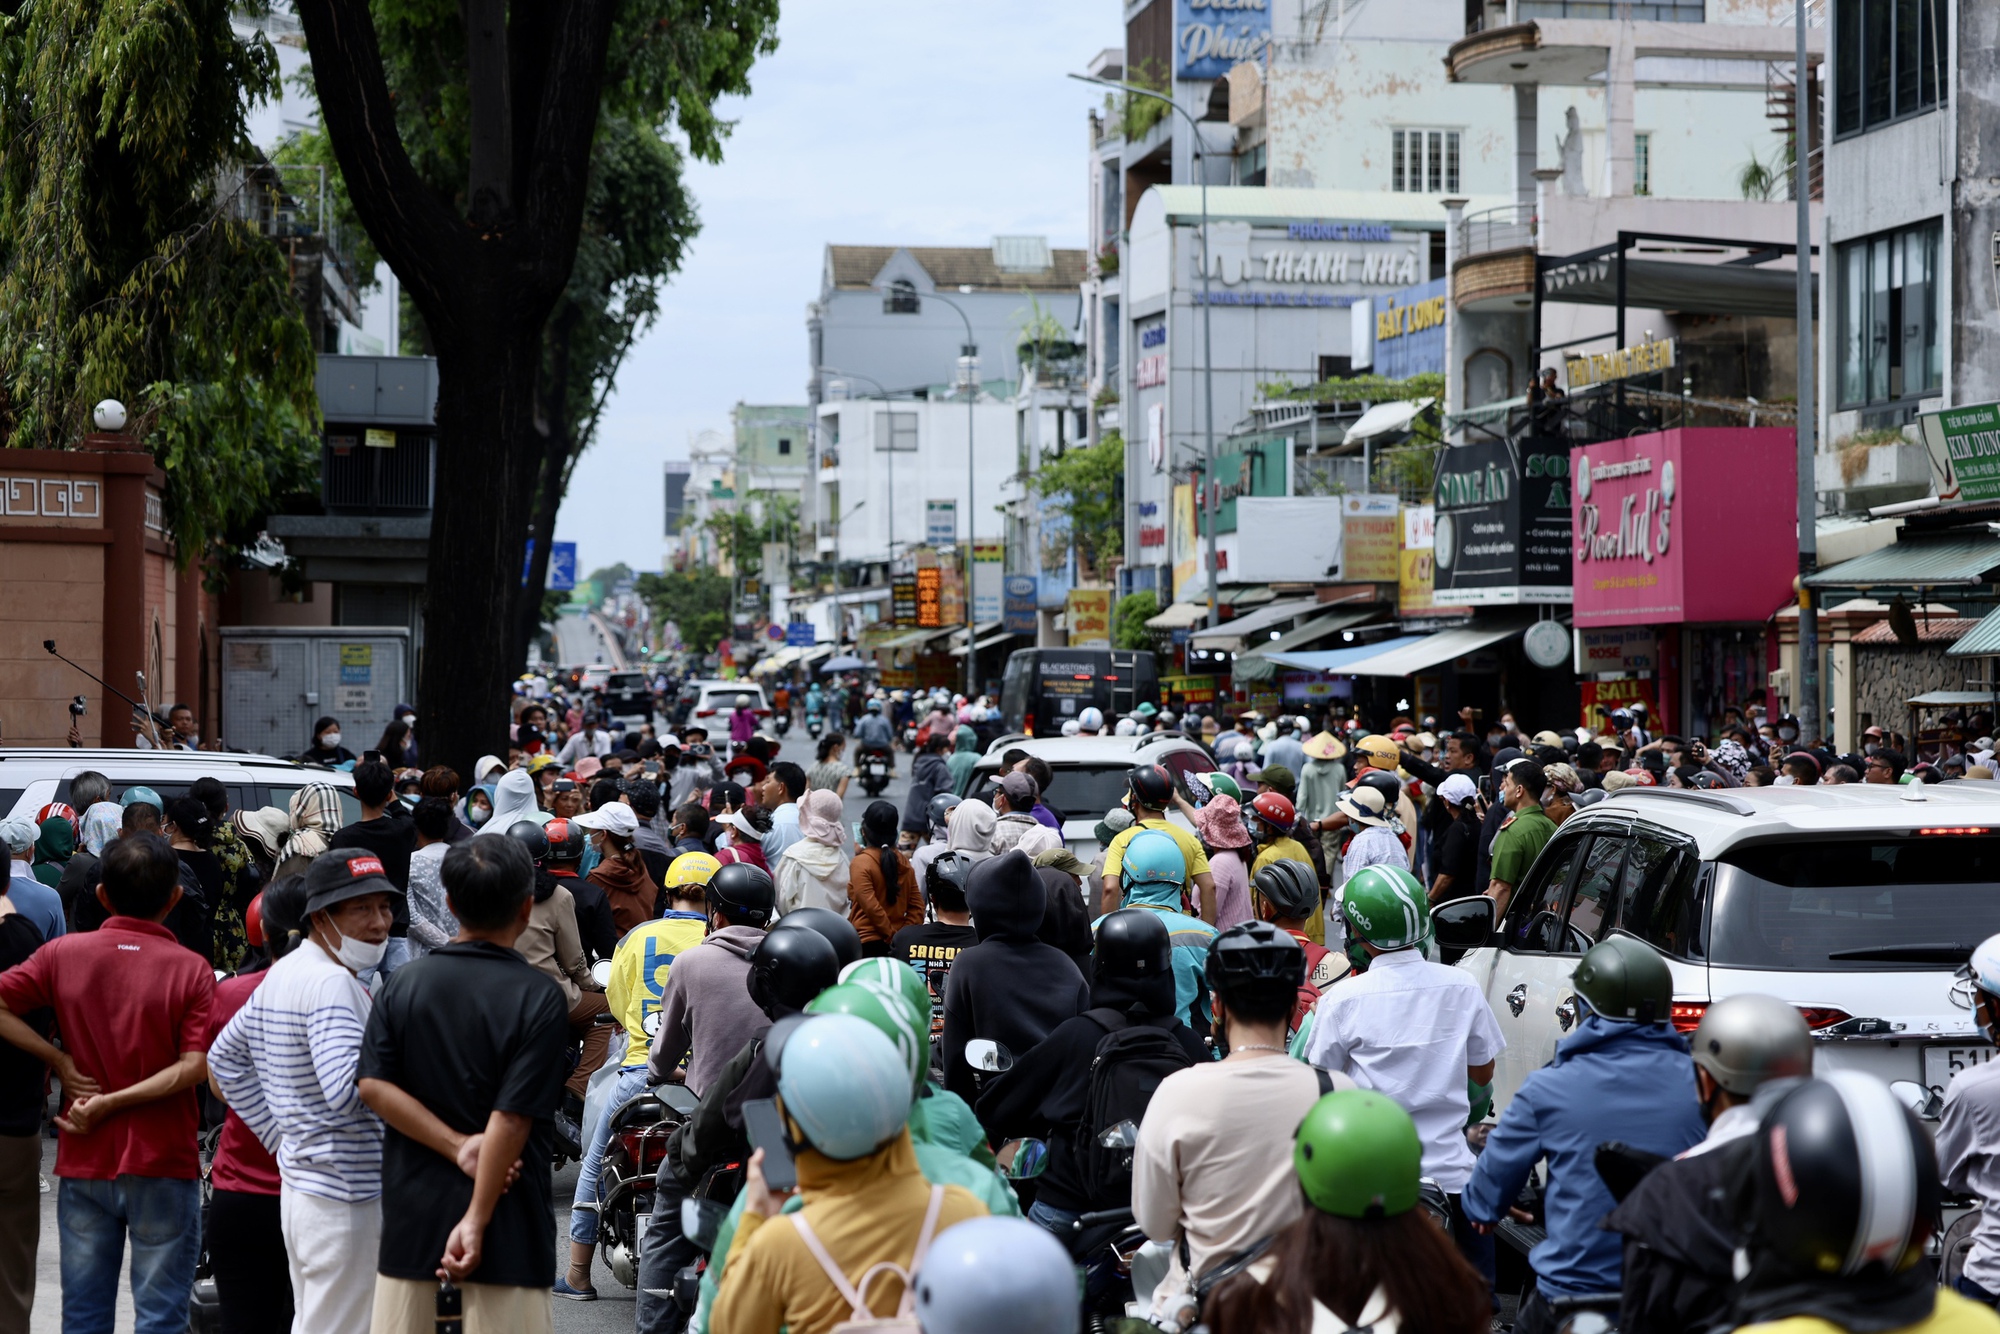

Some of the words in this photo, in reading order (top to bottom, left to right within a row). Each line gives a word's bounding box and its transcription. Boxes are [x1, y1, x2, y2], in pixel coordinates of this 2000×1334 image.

[1262, 250, 1348, 284] THANH
[1407, 294, 1445, 334] LONG
[1947, 434, 1974, 460] KIM
[1526, 453, 1571, 478] SO
[1545, 480, 1572, 509] Â
[1532, 528, 1559, 538] Coffee
[1588, 646, 1621, 659] ROSE
[1596, 681, 1640, 701] SALE
[1376, 751, 1397, 760] CSGT
[1348, 901, 1372, 931] Grab
[928, 960, 944, 968] NHÀ
